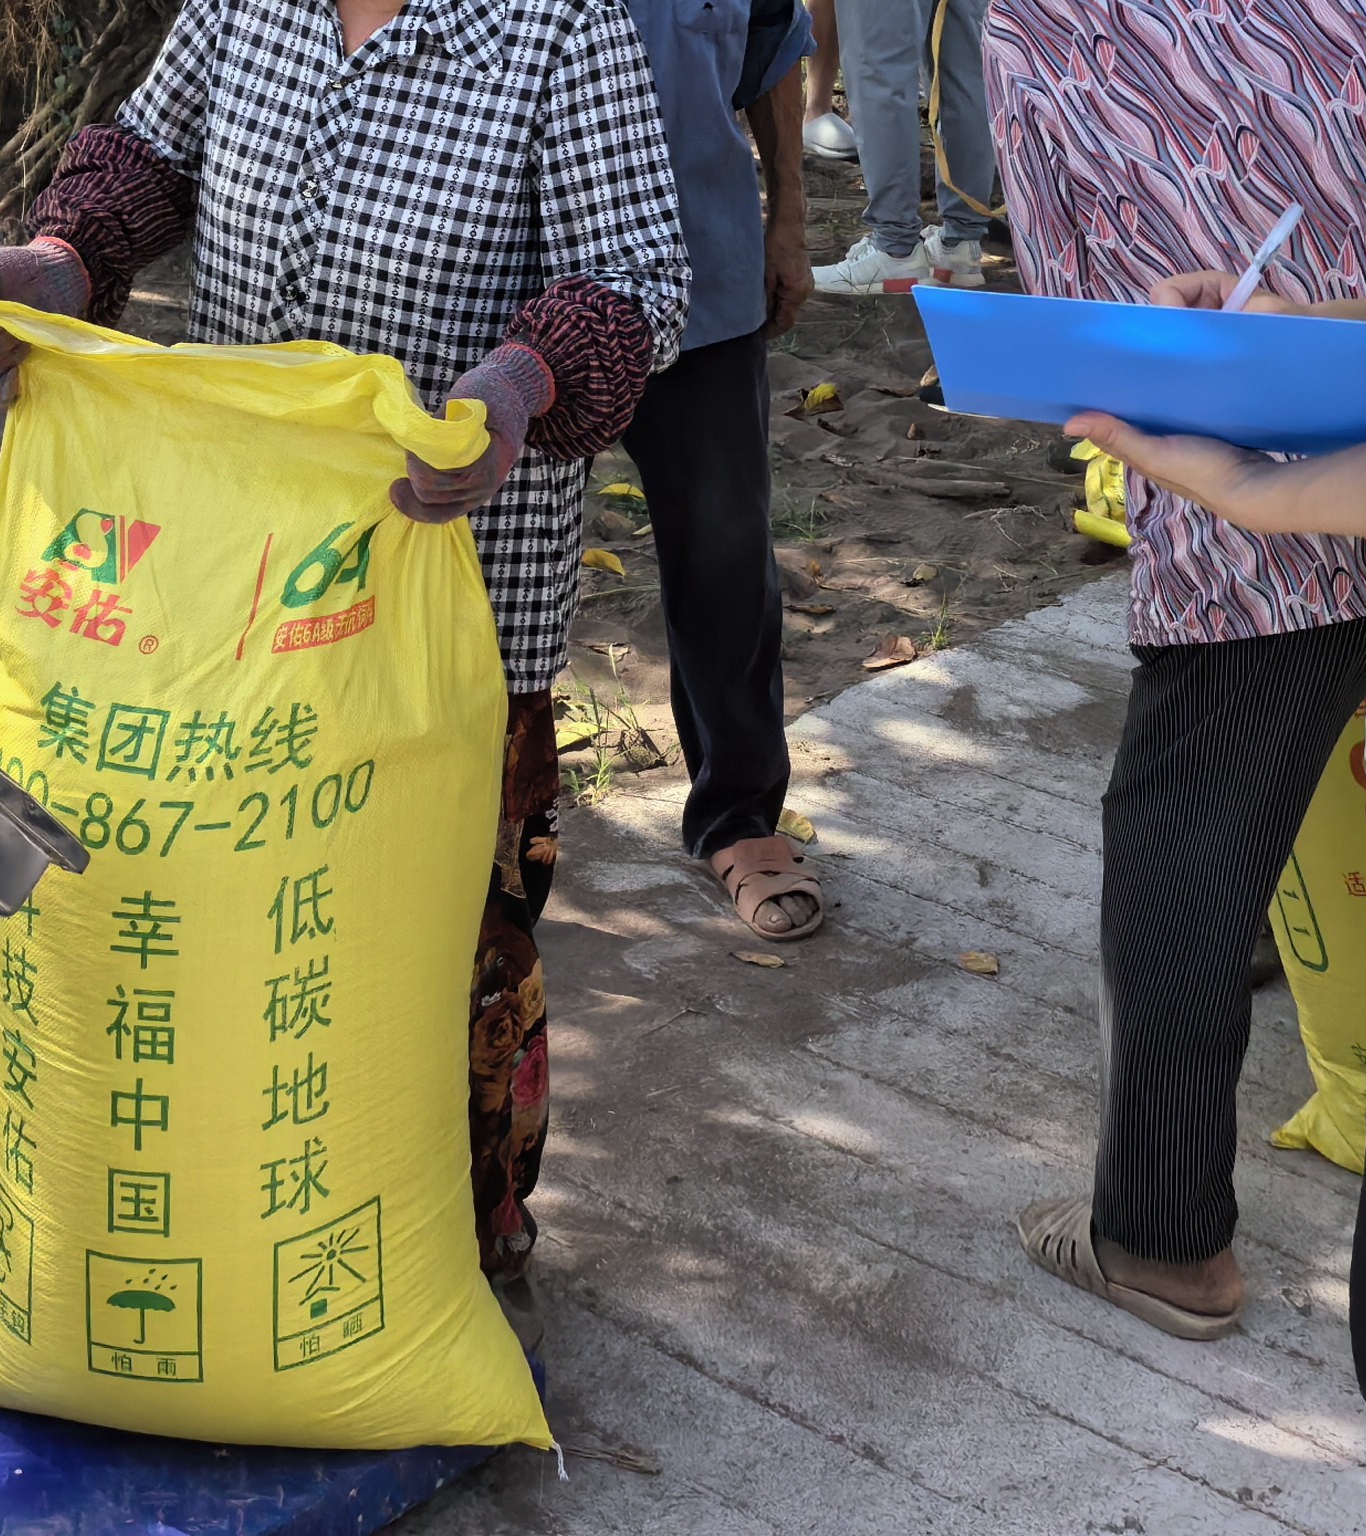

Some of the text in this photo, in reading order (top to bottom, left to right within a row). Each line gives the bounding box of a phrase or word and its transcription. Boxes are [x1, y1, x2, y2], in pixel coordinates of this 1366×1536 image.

[15, 566, 133, 647] 安佑
[37, 681, 319, 781] 集团热线
[106, 890, 182, 1238] 幸福中国
[260, 865, 336, 1220] 低碳地球
